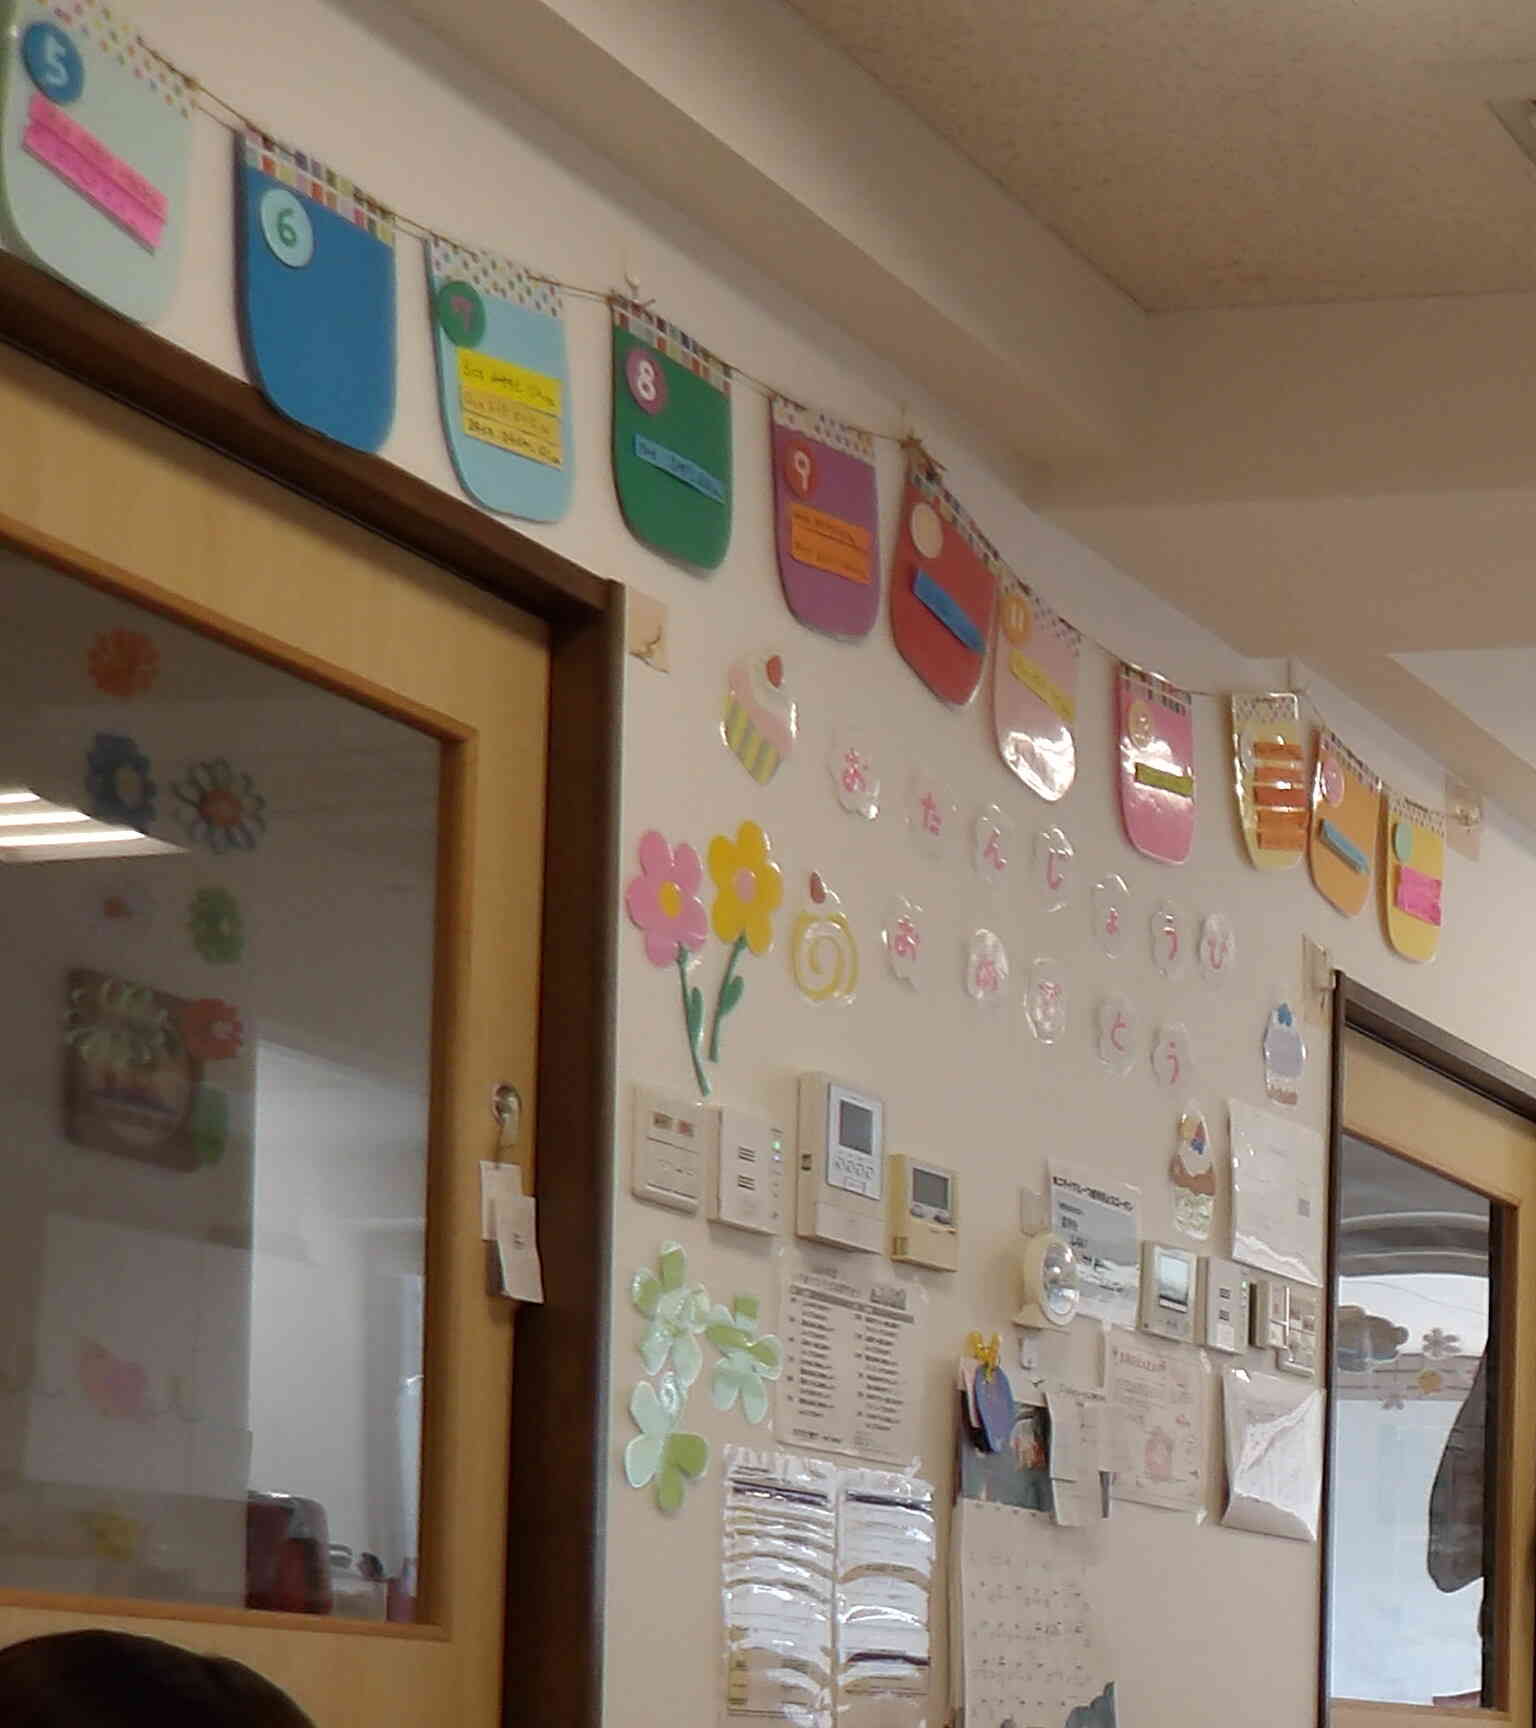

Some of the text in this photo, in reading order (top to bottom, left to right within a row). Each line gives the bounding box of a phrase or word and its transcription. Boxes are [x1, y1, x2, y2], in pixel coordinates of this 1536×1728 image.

[46, 35, 70, 87] 5
[276, 207, 298, 247] 6
[450, 295, 475, 336] 7
[637, 359, 657, 401] 8
[793, 448, 811, 493] 9
